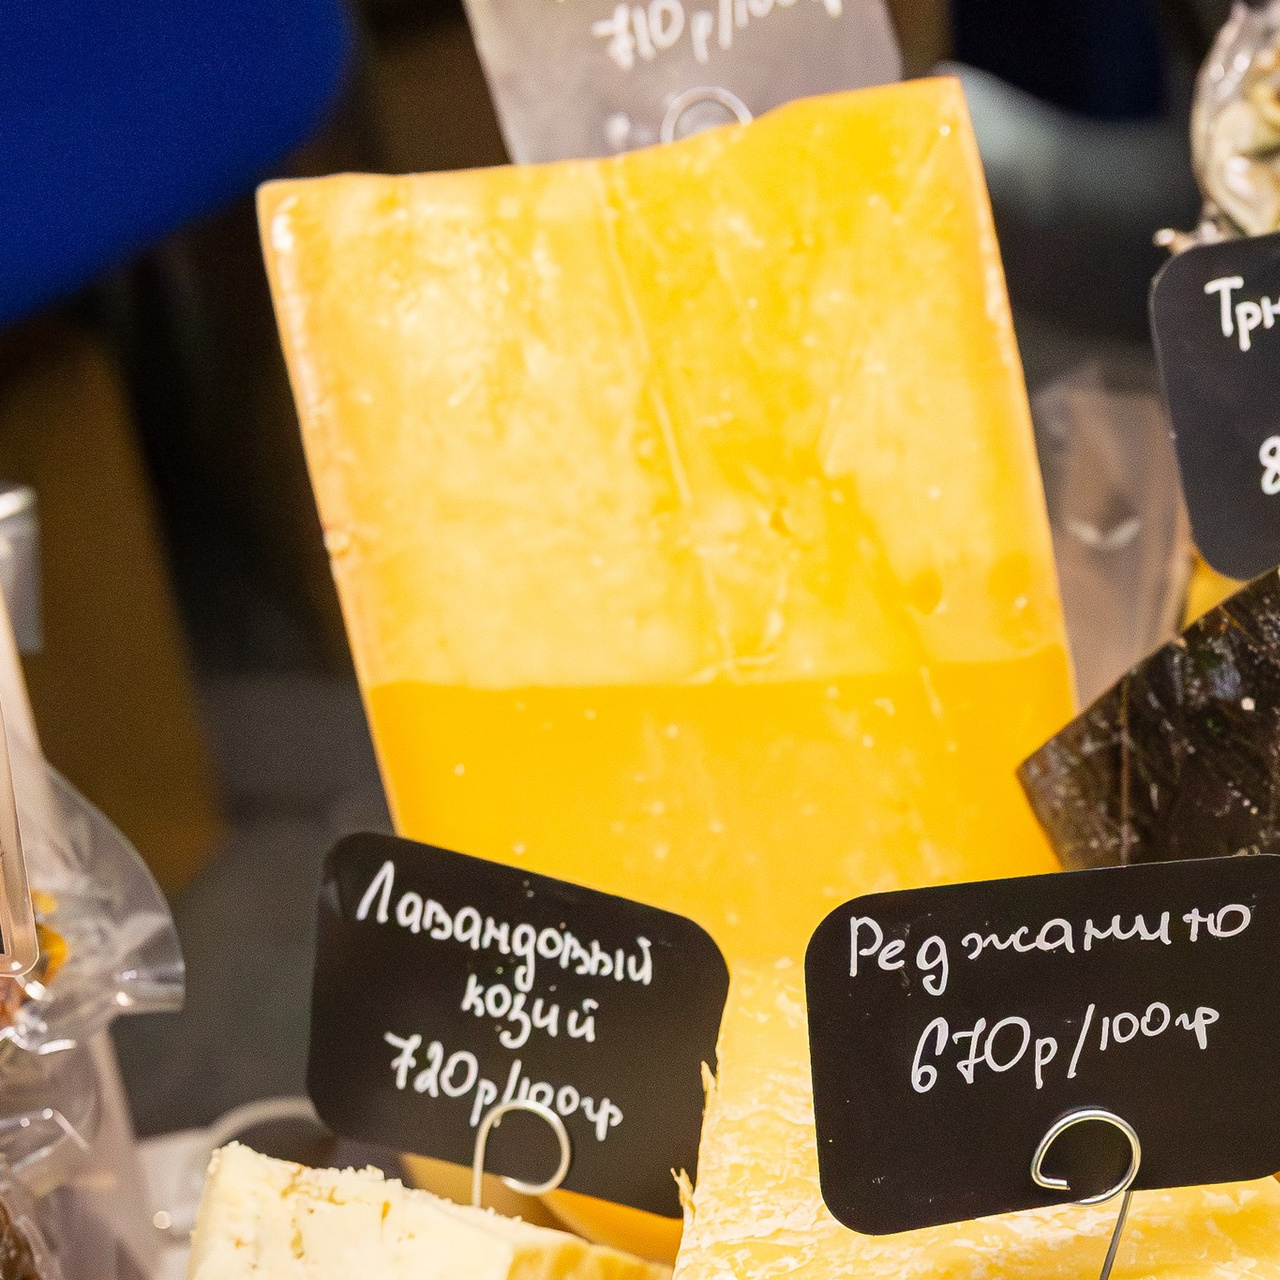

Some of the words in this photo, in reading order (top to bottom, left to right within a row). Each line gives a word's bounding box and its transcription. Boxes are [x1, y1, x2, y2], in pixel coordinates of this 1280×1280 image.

[356, 860, 654, 992] Лавандовый
[461, 974, 599, 1050] козий
[910, 1001, 1220, 1094] 670р/100гр
